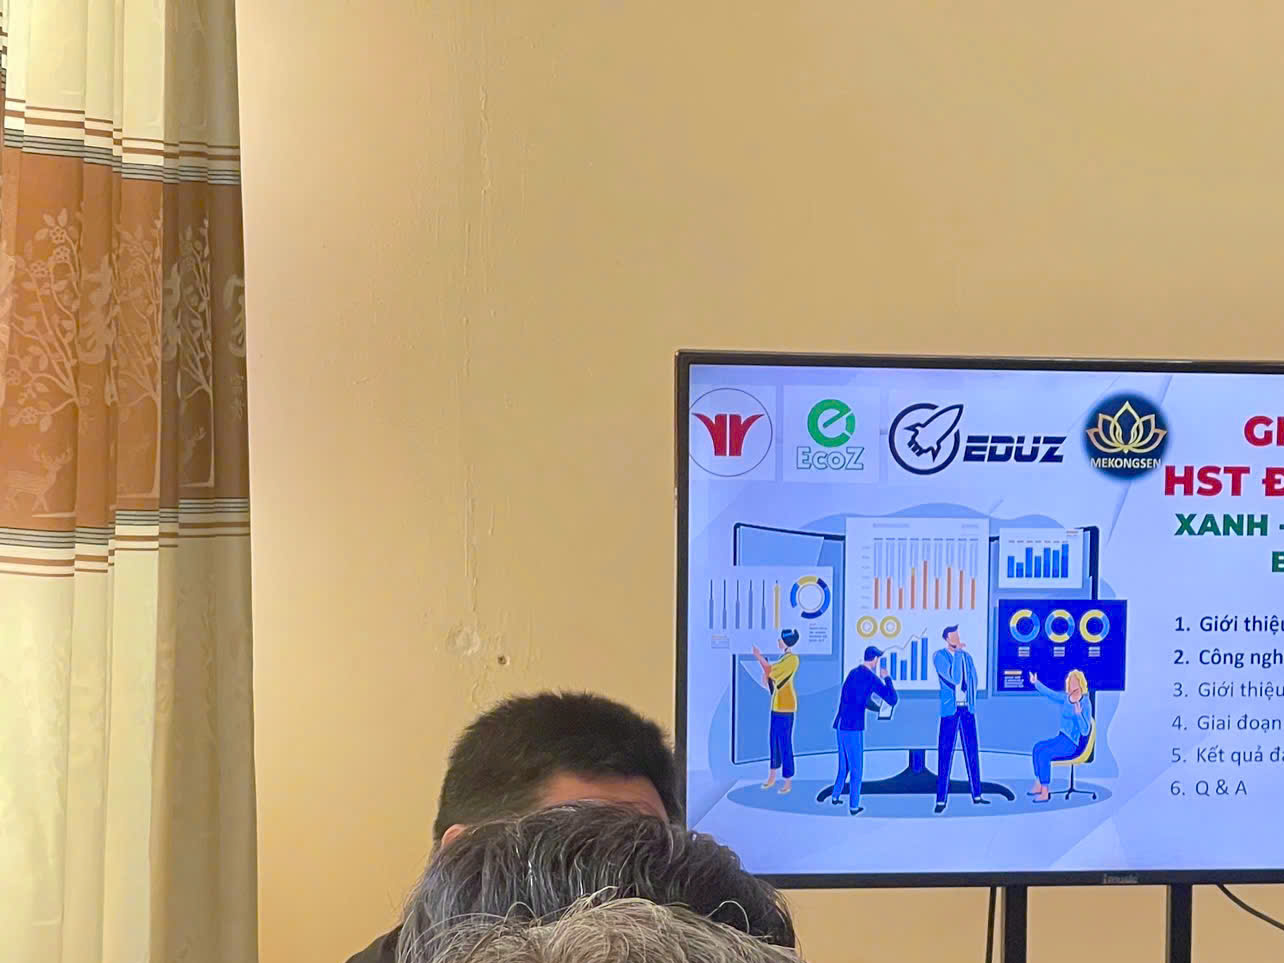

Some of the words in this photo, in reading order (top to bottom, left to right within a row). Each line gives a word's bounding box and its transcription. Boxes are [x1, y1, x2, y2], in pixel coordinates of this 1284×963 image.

[963, 436, 1068, 463] EDUZ
[1091, 457, 1161, 469] MEKONGSEN
[1165, 465, 1250, 496] HST
[1174, 513, 1268, 536] XANH
[1175, 616, 1190, 631] 1.
[1200, 614, 1238, 632] Giới
[1174, 649, 1189, 664] 2.
[1199, 648, 1244, 669] Công
[1173, 682, 1188, 697] 3.
[1198, 681, 1233, 697] Giới
[1240, 681, 1284, 700] thiệu
[1172, 716, 1187, 730] 4.
[1198, 715, 1230, 730] Giai
[1237, 714, 1281, 733] đoạn
[1172, 748, 1186, 763] 5.
[1197, 745, 1224, 762] Kết
[1231, 745, 1263, 766] quả
[1171, 781, 1185, 795] 6.
[1196, 780, 1210, 797] Q
[1216, 779, 1229, 795] &
[1235, 780, 1247, 795] A
